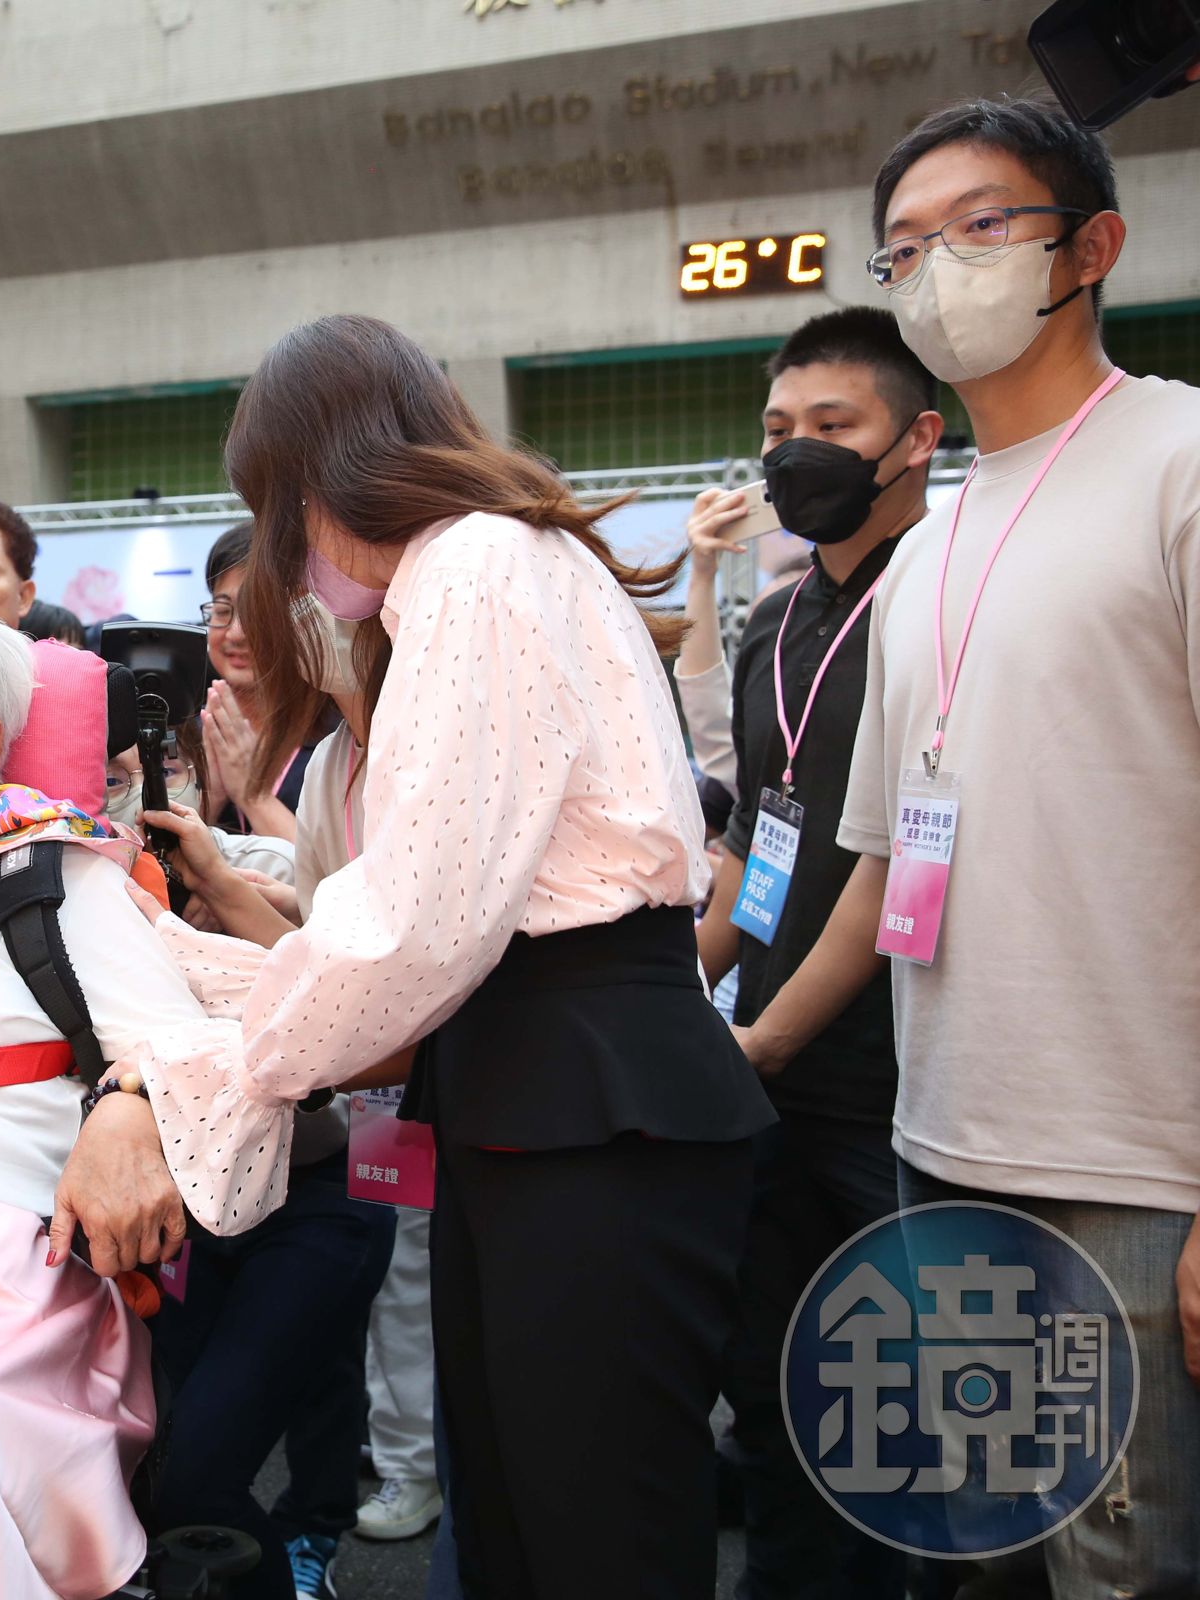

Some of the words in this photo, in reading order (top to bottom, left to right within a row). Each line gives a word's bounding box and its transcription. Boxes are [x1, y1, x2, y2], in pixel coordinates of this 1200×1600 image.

[828, 42, 937, 86] New
[902, 808, 953, 829] 真愛母親節
[749, 867, 775, 890] STAFF
[745, 880, 767, 902] PASS
[886, 912, 914, 935] 親友證
[356, 1163, 399, 1184] 親友證
